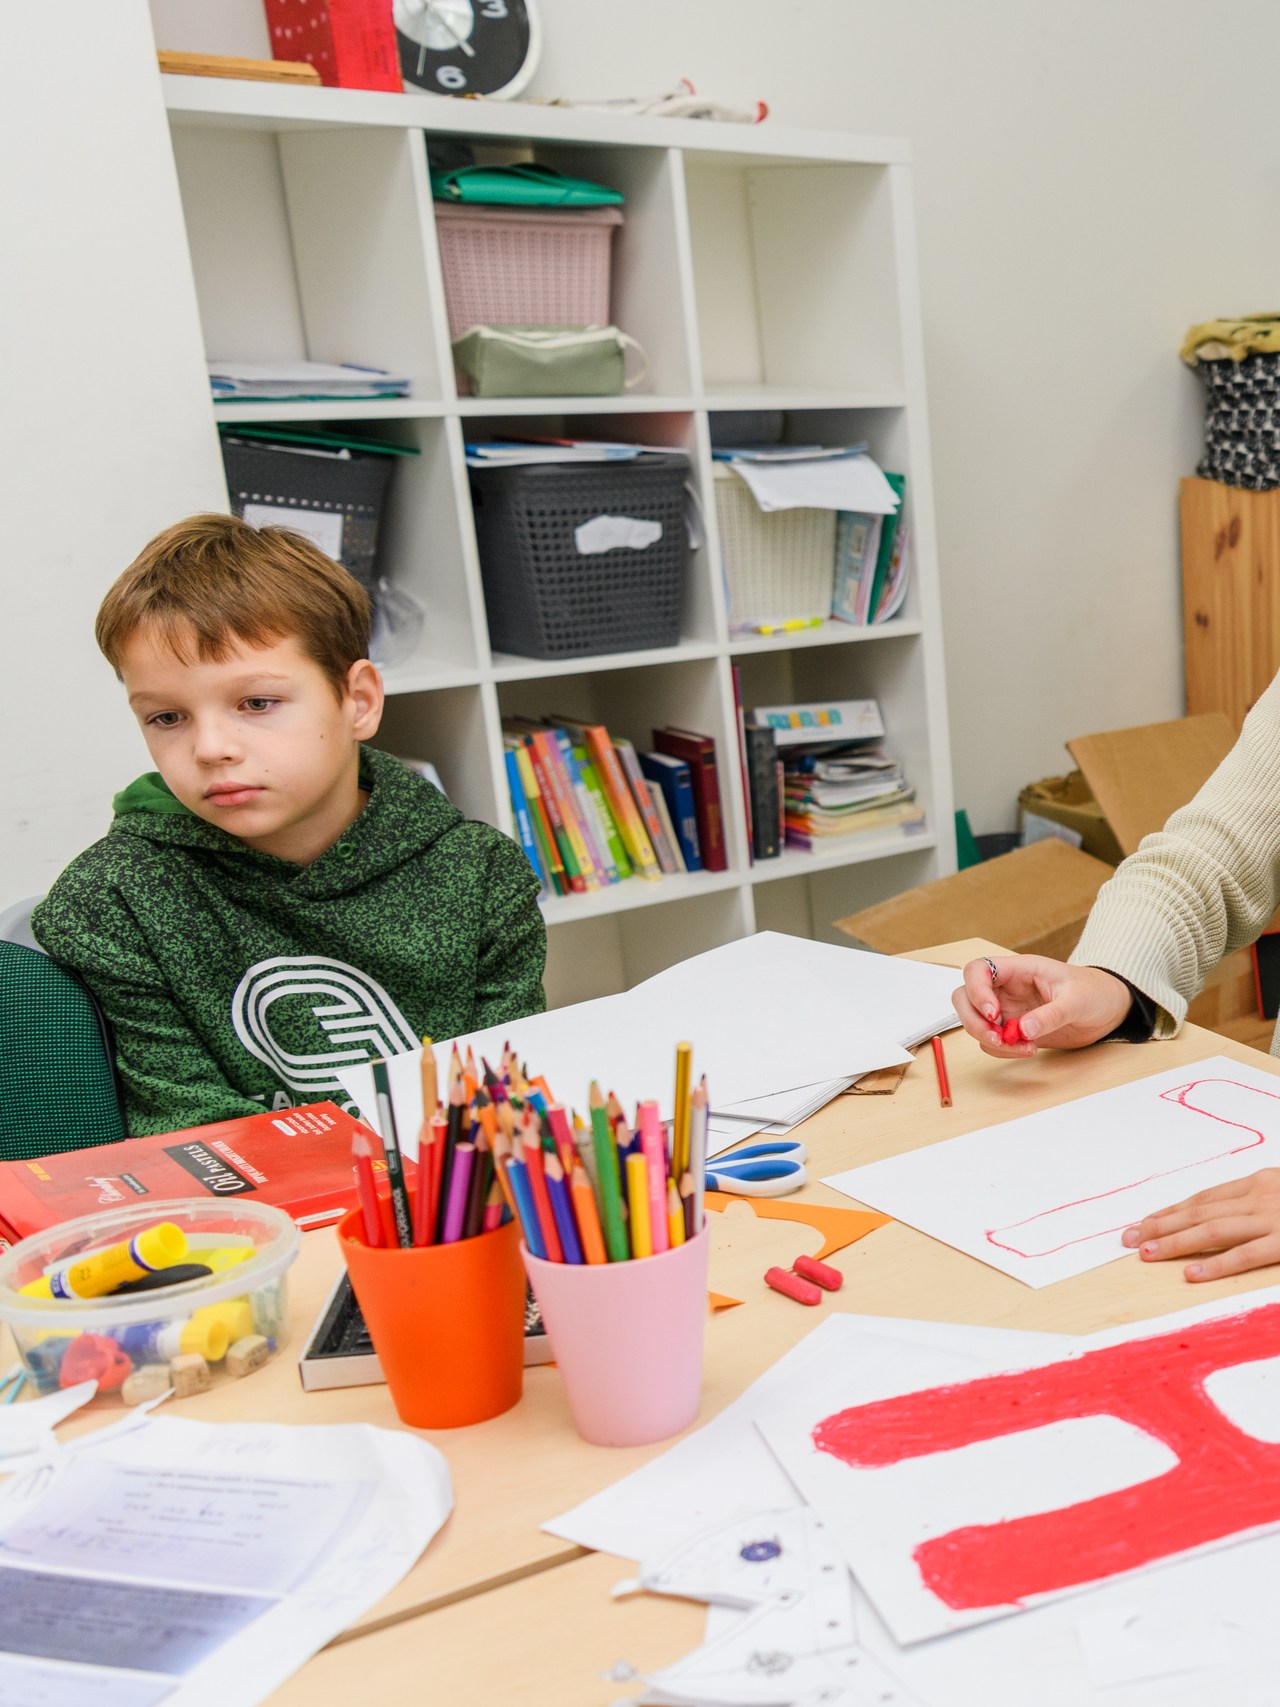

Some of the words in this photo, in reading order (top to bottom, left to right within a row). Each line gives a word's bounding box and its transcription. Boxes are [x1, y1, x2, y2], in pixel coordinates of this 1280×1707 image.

[435, 65, 467, 90] 6
[183, 1144, 224, 1172] PASTELS
[204, 1171, 246, 1192] Oil
